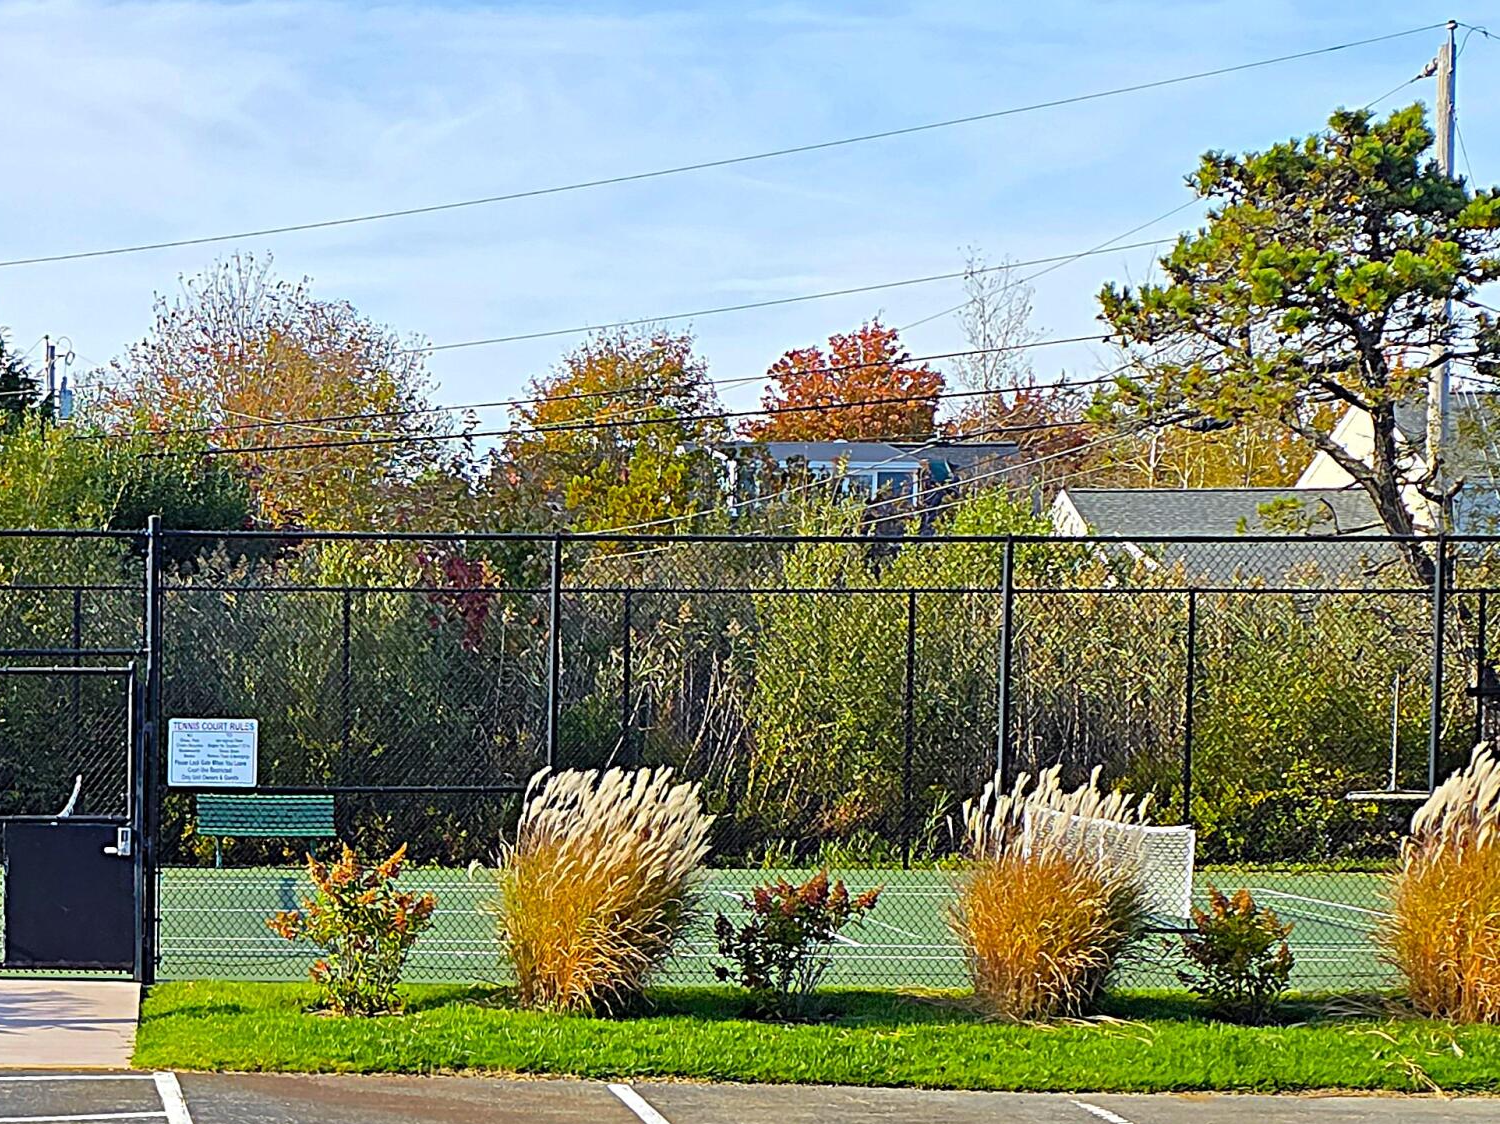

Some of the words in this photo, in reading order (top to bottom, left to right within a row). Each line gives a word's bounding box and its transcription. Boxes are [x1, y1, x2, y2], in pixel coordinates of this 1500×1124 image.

[173, 722, 199, 730] TENNIS
[202, 722, 227, 731] COURT
[230, 723, 254, 731] RULES
